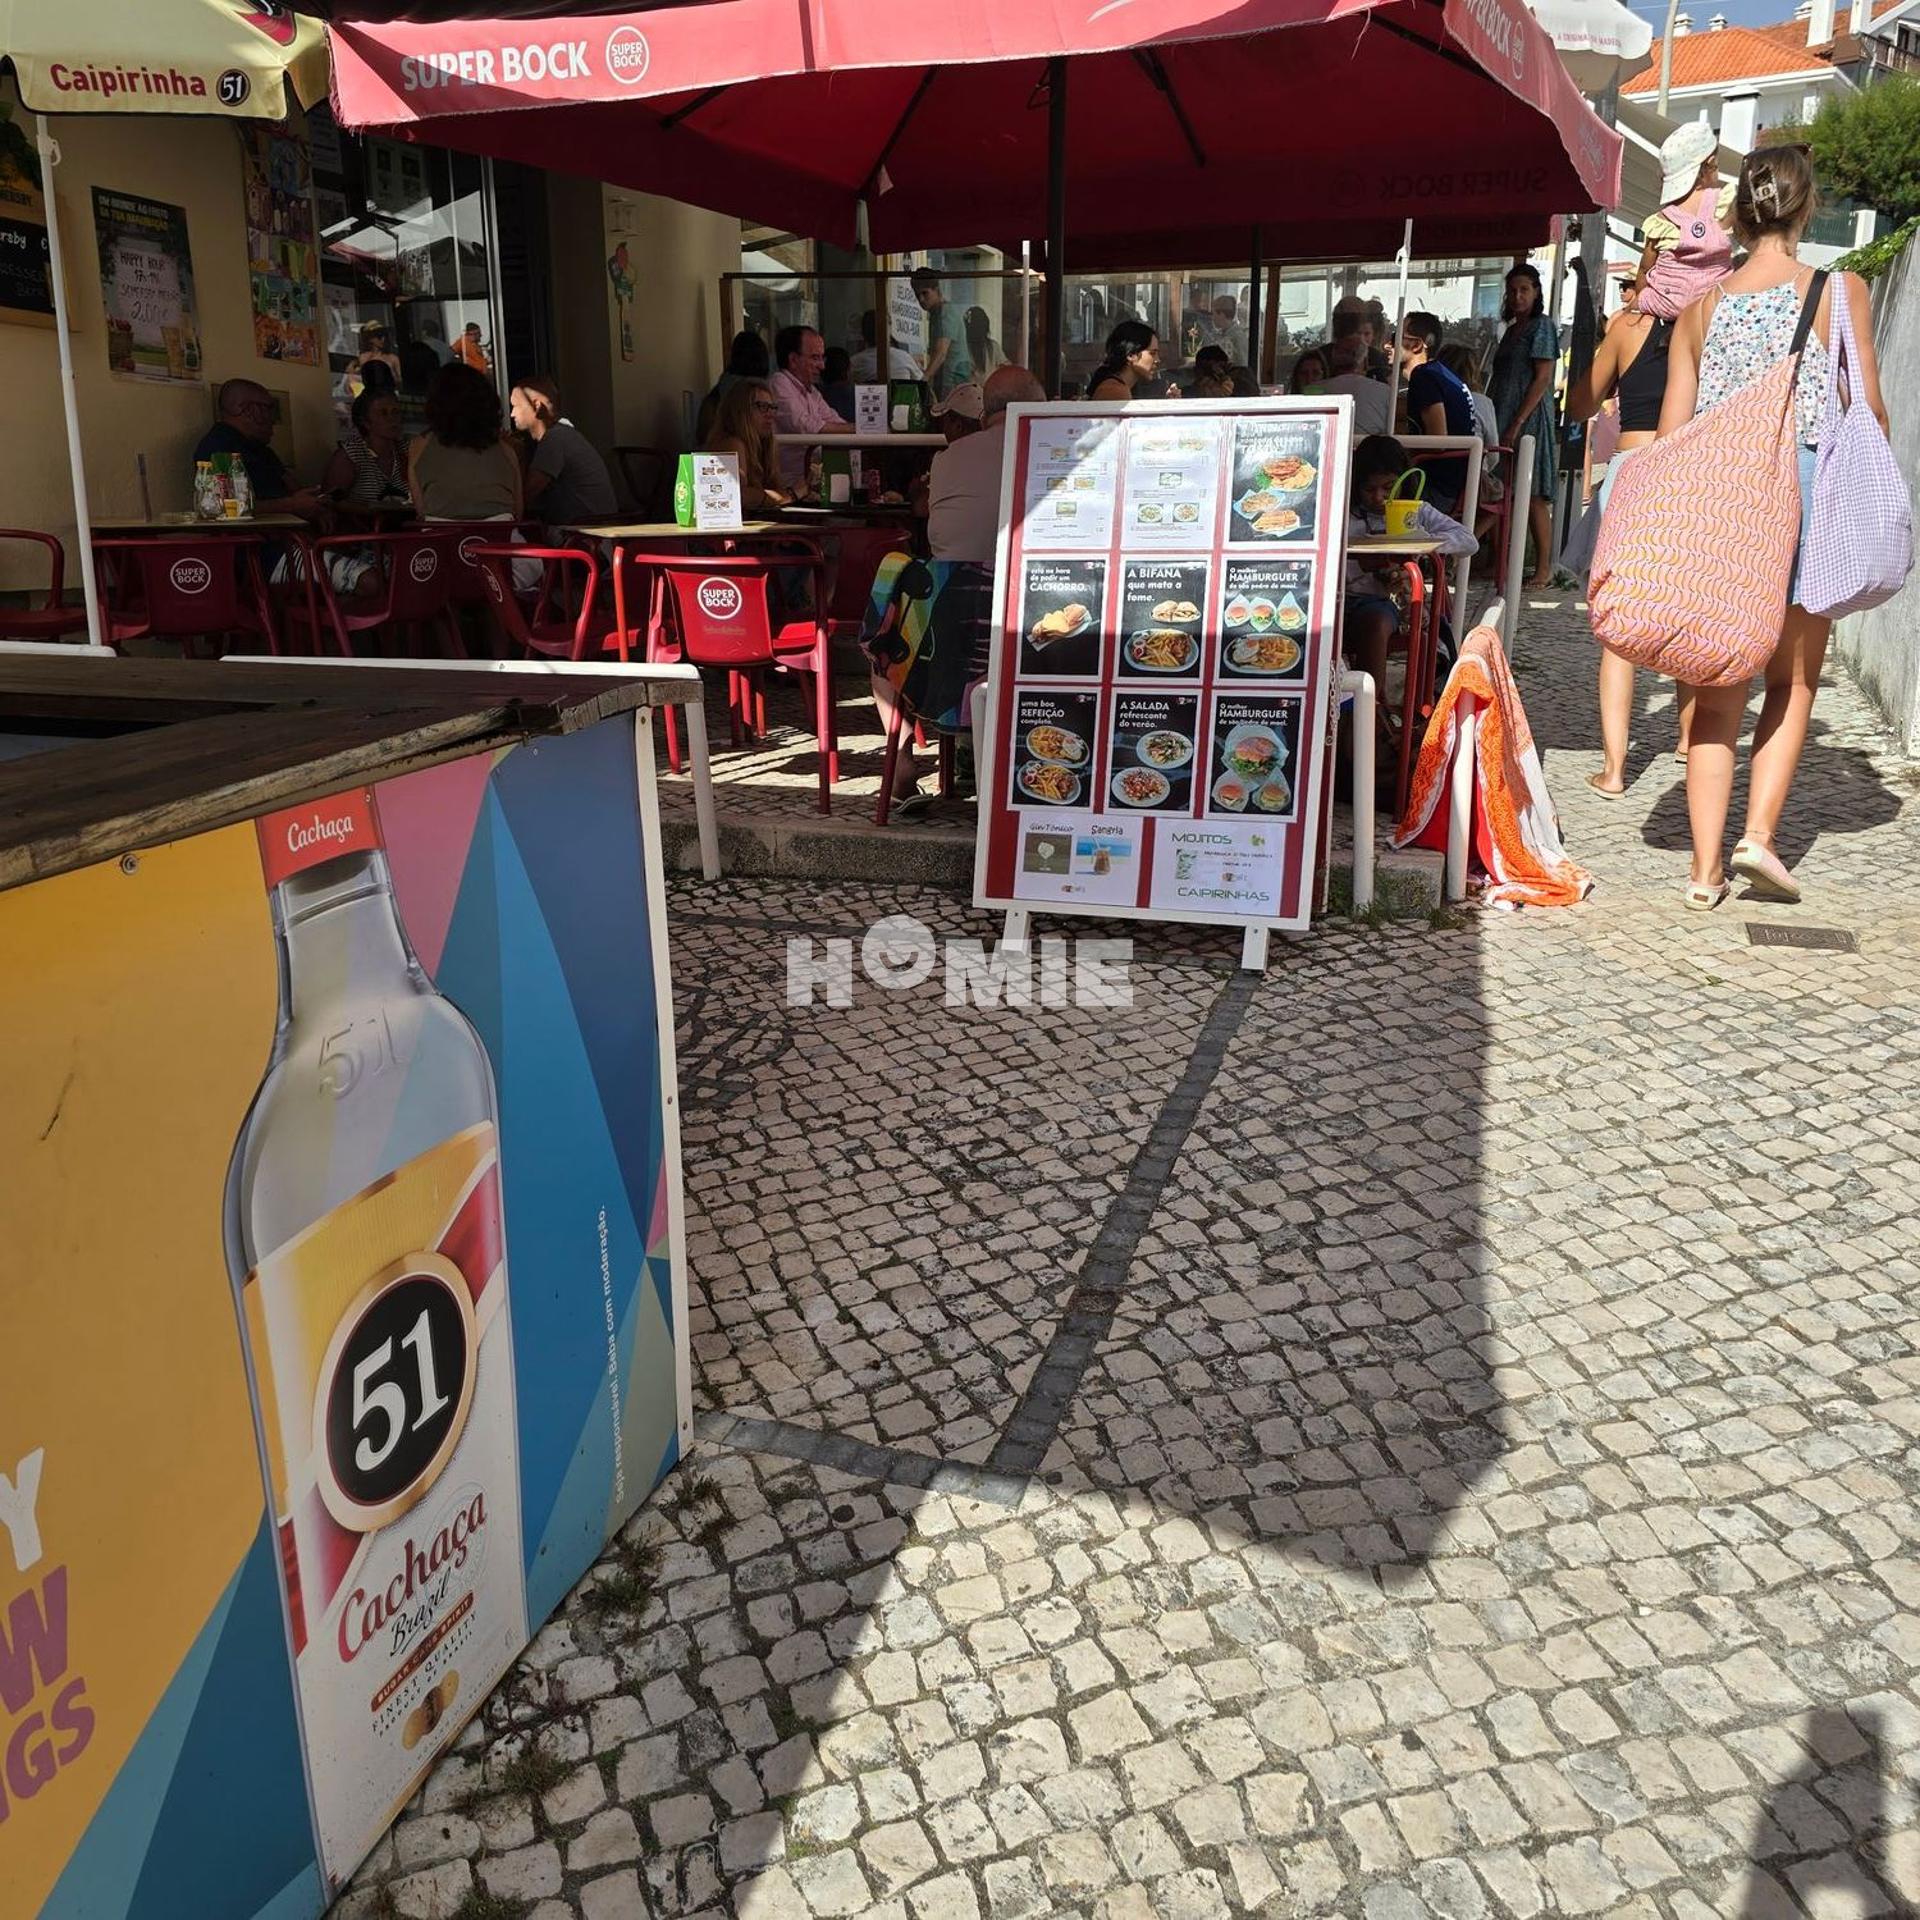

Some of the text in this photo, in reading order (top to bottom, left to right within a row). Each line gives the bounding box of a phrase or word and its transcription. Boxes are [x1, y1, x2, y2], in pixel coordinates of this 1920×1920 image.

[611, 41, 643, 56] SUPER
[402, 41, 592, 91] SUPER BOCK
[613, 53, 643, 68] BOCK
[50, 63, 207, 97] Caipirinha
[221, 75, 243, 101] 51
[1, 231, 27, 249] rsby
[120, 251, 144, 268] HAPPY
[414, 556, 434, 566] SUPER
[175, 567, 206, 577] SUPER
[414, 564, 433, 573] BOCK
[1128, 568, 1182, 579] A BIFANA
[177, 574, 205, 584] BOCK
[1229, 573, 1298, 582] HAMBURGUER
[1029, 582, 1088, 592] CACHORRO.
[1127, 582, 1145, 591] que
[1148, 581, 1173, 589] mata
[702, 588, 736, 599] SUPER
[1127, 593, 1155, 602] fome.
[705, 597, 736, 608] BOCK
[1040, 700, 1055, 708] boa
[1120, 701, 1170, 711] A SALADA
[1020, 707, 1065, 719] REFEIÇÃO
[1120, 711, 1168, 720] refrescante
[1219, 709, 1289, 719] HAMBURGUER
[1119, 719, 1158, 729] do verão.
[287, 813, 355, 853] Cachaça
[1092, 825, 1124, 836] Sangria
[1172, 833, 1233, 845] MOJITOS
[1178, 887, 1270, 902] CAIPIRINHAS
[318, 1004, 406, 1099] 51
[598, 1204, 613, 1297] moderação.
[605, 1298, 615, 1332] com
[608, 1333, 618, 1375] Beba
[352, 1308, 449, 1472] 51
[337, 1491, 487, 1663] Cachaça
[389, 1566, 452, 1658] Brazil
[377, 1663, 410, 1703] SUGAR
[441, 1599, 471, 1635] SPIRIT
[372, 1675, 420, 1734] FINEST
[424, 1610, 478, 1674] QUALITY
[0, 1676, 96, 1824] GS
